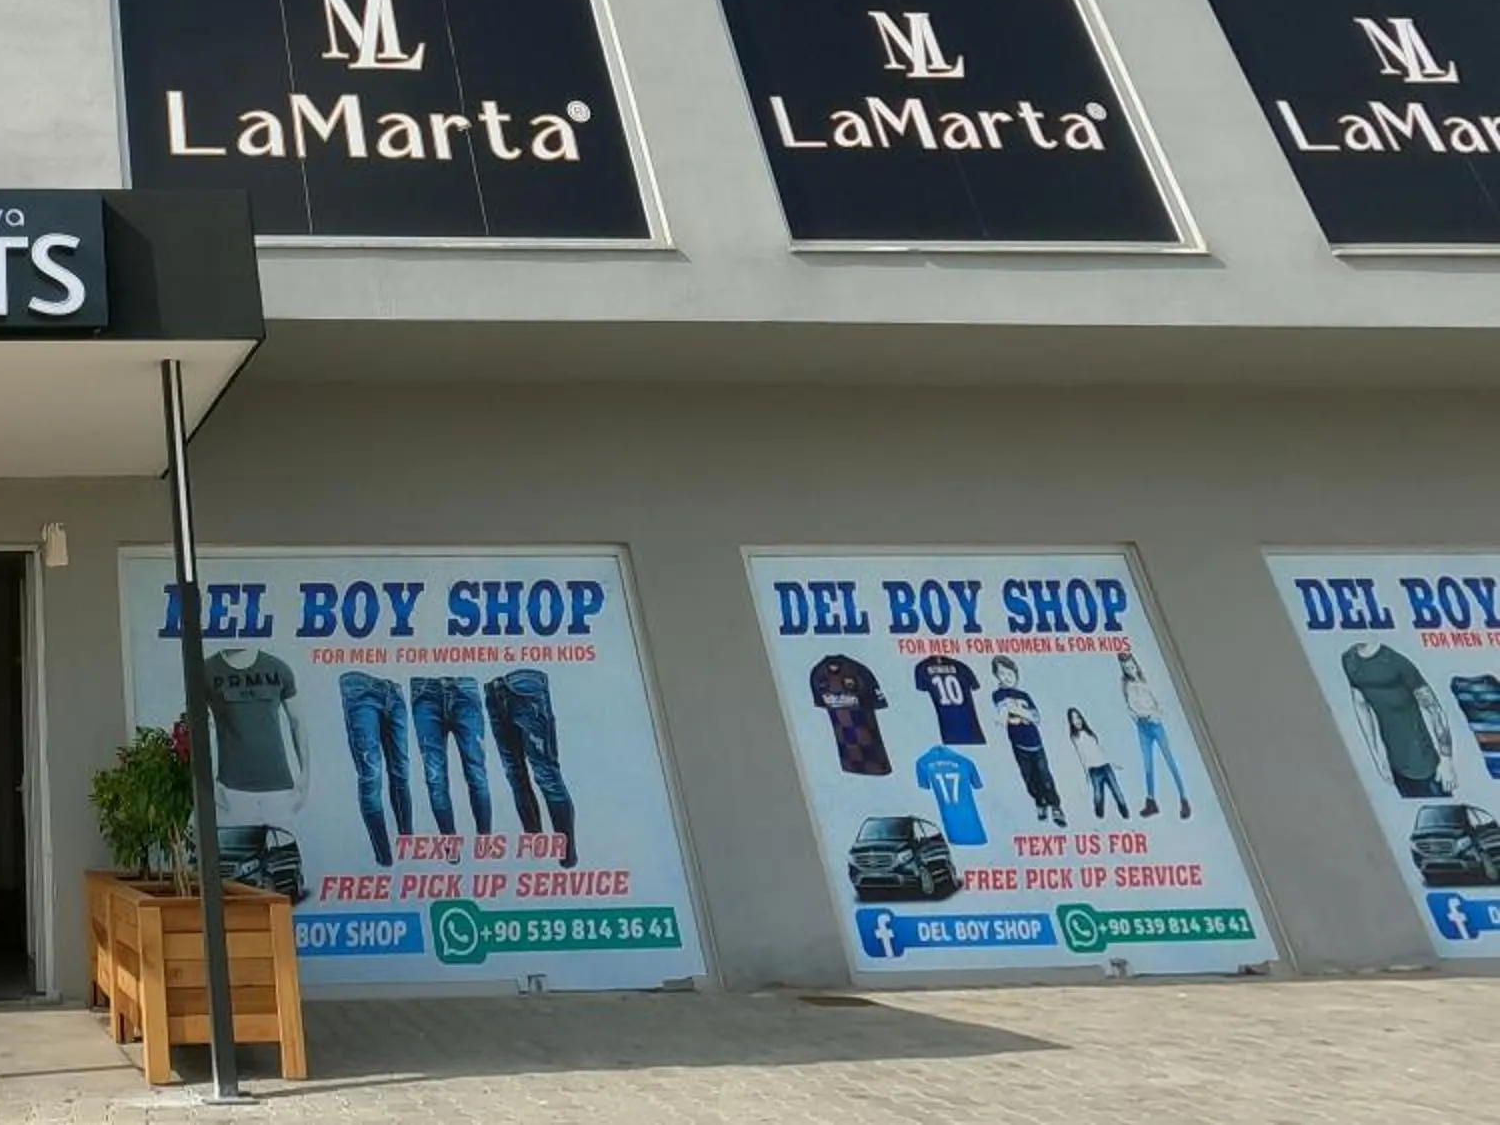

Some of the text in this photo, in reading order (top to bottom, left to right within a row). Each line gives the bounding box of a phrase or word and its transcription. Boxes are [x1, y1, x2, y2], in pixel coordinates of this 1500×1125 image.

[296, 580, 425, 639] BOY
[448, 579, 605, 638] SHOP
[774, 578, 1127, 635] DEL BOY SHOP
[1294, 576, 1500, 630] DEL BOY
[898, 638, 926, 654] FOR
[929, 638, 960, 653] MEN
[967, 638, 994, 653] FOR
[996, 637, 1051, 653] WOMEN
[1068, 637, 1097, 653] FOR
[1100, 636, 1131, 652] KIDS
[1421, 632, 1450, 647] FOR
[1452, 632, 1483, 647] MEN
[312, 645, 596, 664] FOR MEN FOR WOMEN & FOR KIDS
[931, 674, 964, 706] 10
[935, 773, 960, 804] 17
[396, 833, 567, 861] TEXT US FOR
[1014, 833, 1148, 858] TEXT US FOR
[320, 871, 629, 902] FREE PICK UP SERVICE
[964, 865, 1203, 891] FREE PICK UP SERVICE
[296, 920, 407, 948] BOY SHOP
[528, 921, 566, 942] 539
[572, 919, 612, 941] 814
[618, 918, 644, 939] 36
[649, 917, 675, 938] 41
[917, 919, 1042, 942] DEL BOY SHOP
[1135, 918, 1165, 936] 539
[1169, 917, 1201, 935] 814
[1204, 916, 1225, 933] 36
[1228, 915, 1250, 932] 41
